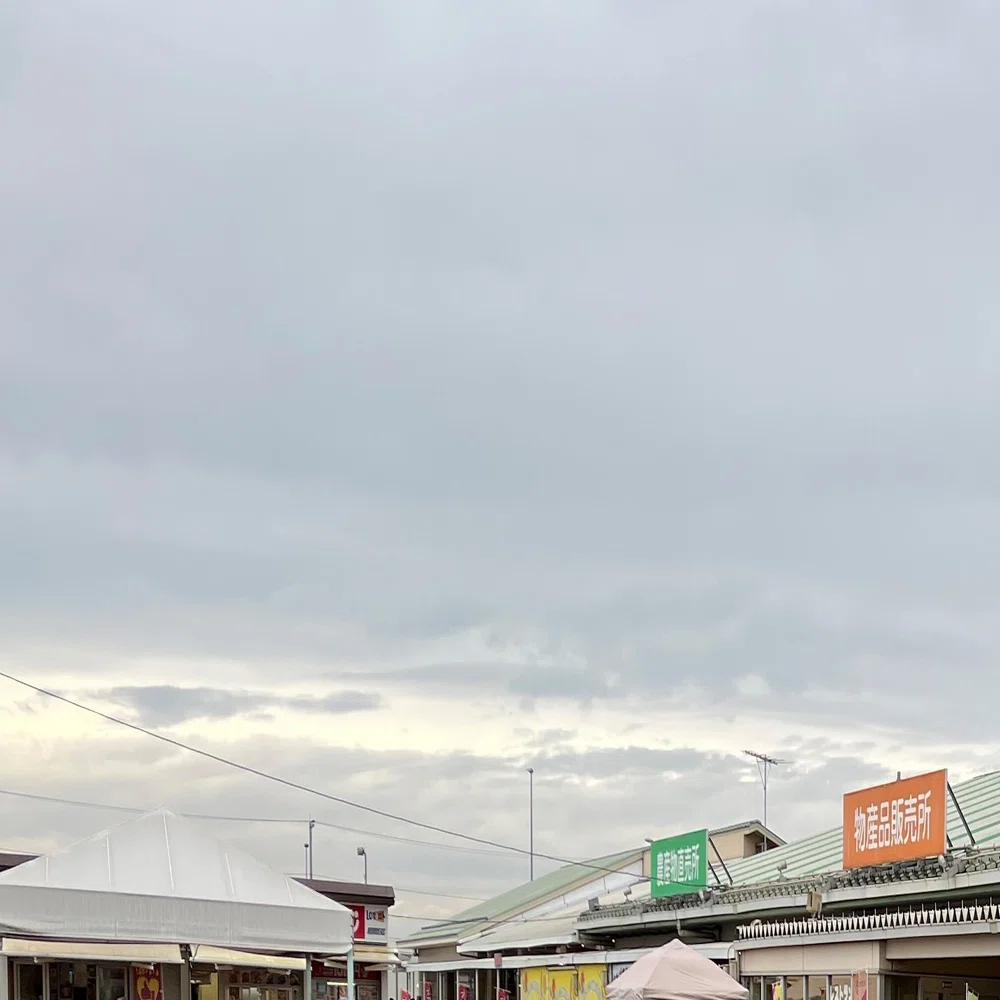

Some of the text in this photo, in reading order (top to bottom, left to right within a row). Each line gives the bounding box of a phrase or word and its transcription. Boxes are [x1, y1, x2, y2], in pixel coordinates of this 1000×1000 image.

[853, 790, 932, 853] 物産品販売所
